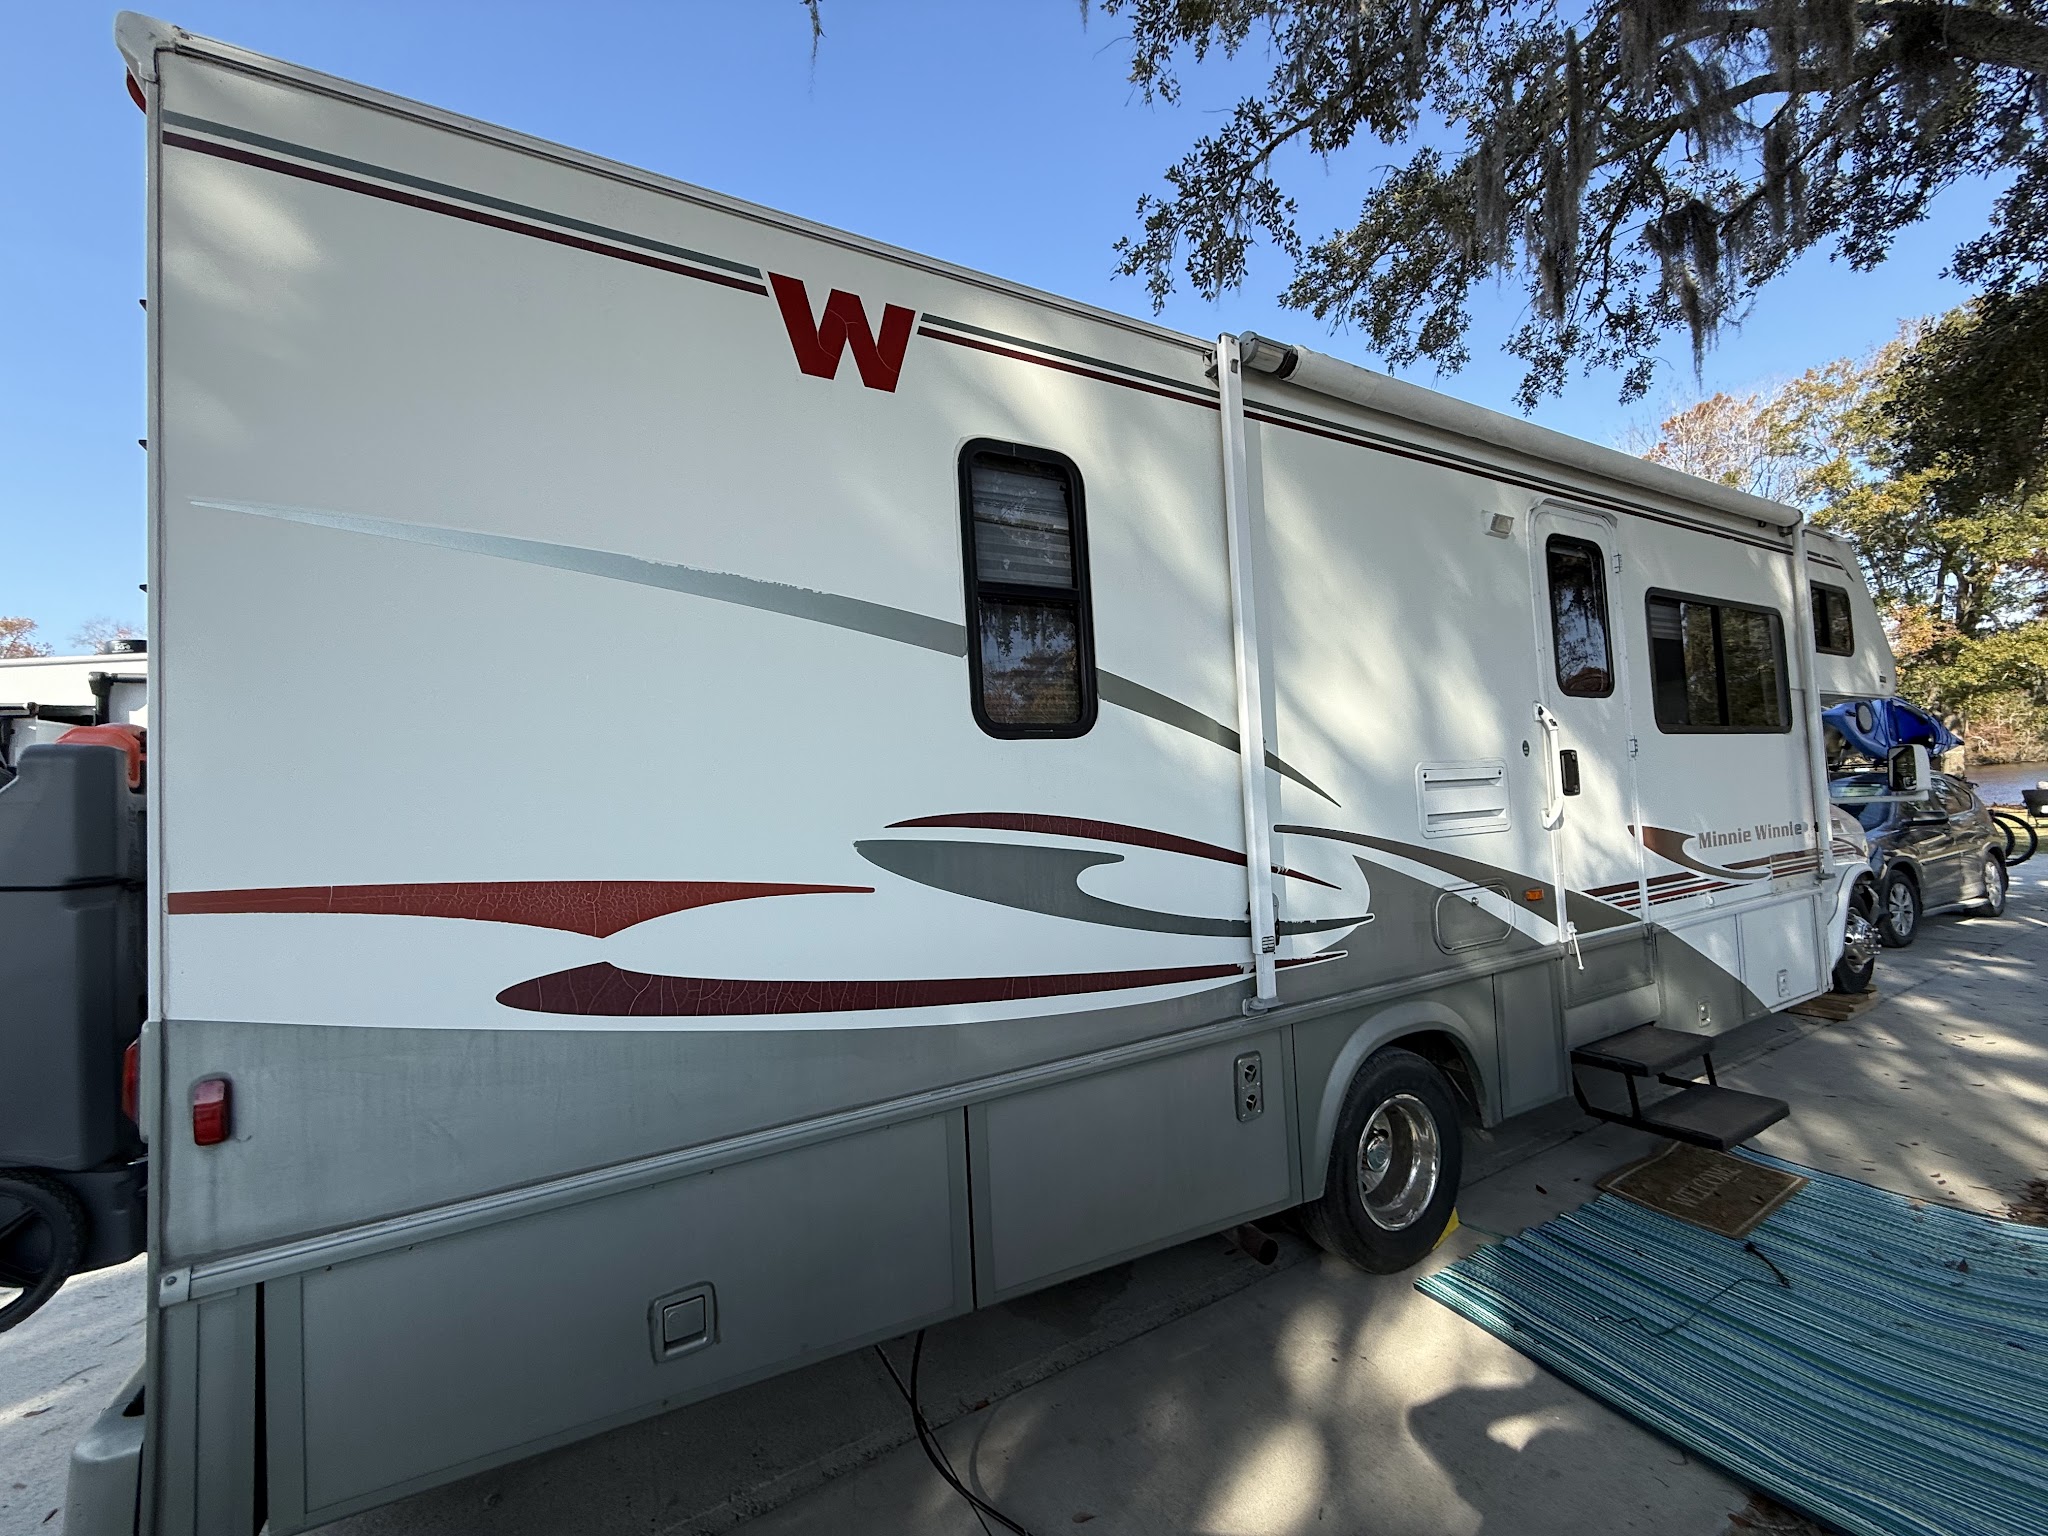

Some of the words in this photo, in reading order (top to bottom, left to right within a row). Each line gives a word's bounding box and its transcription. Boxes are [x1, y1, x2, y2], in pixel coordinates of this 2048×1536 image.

[768, 271, 916, 393] W
[1699, 828, 1751, 849] Minnie
[1754, 821, 1802, 840] Winnie
[1665, 1164, 1743, 1208] WELCOME
